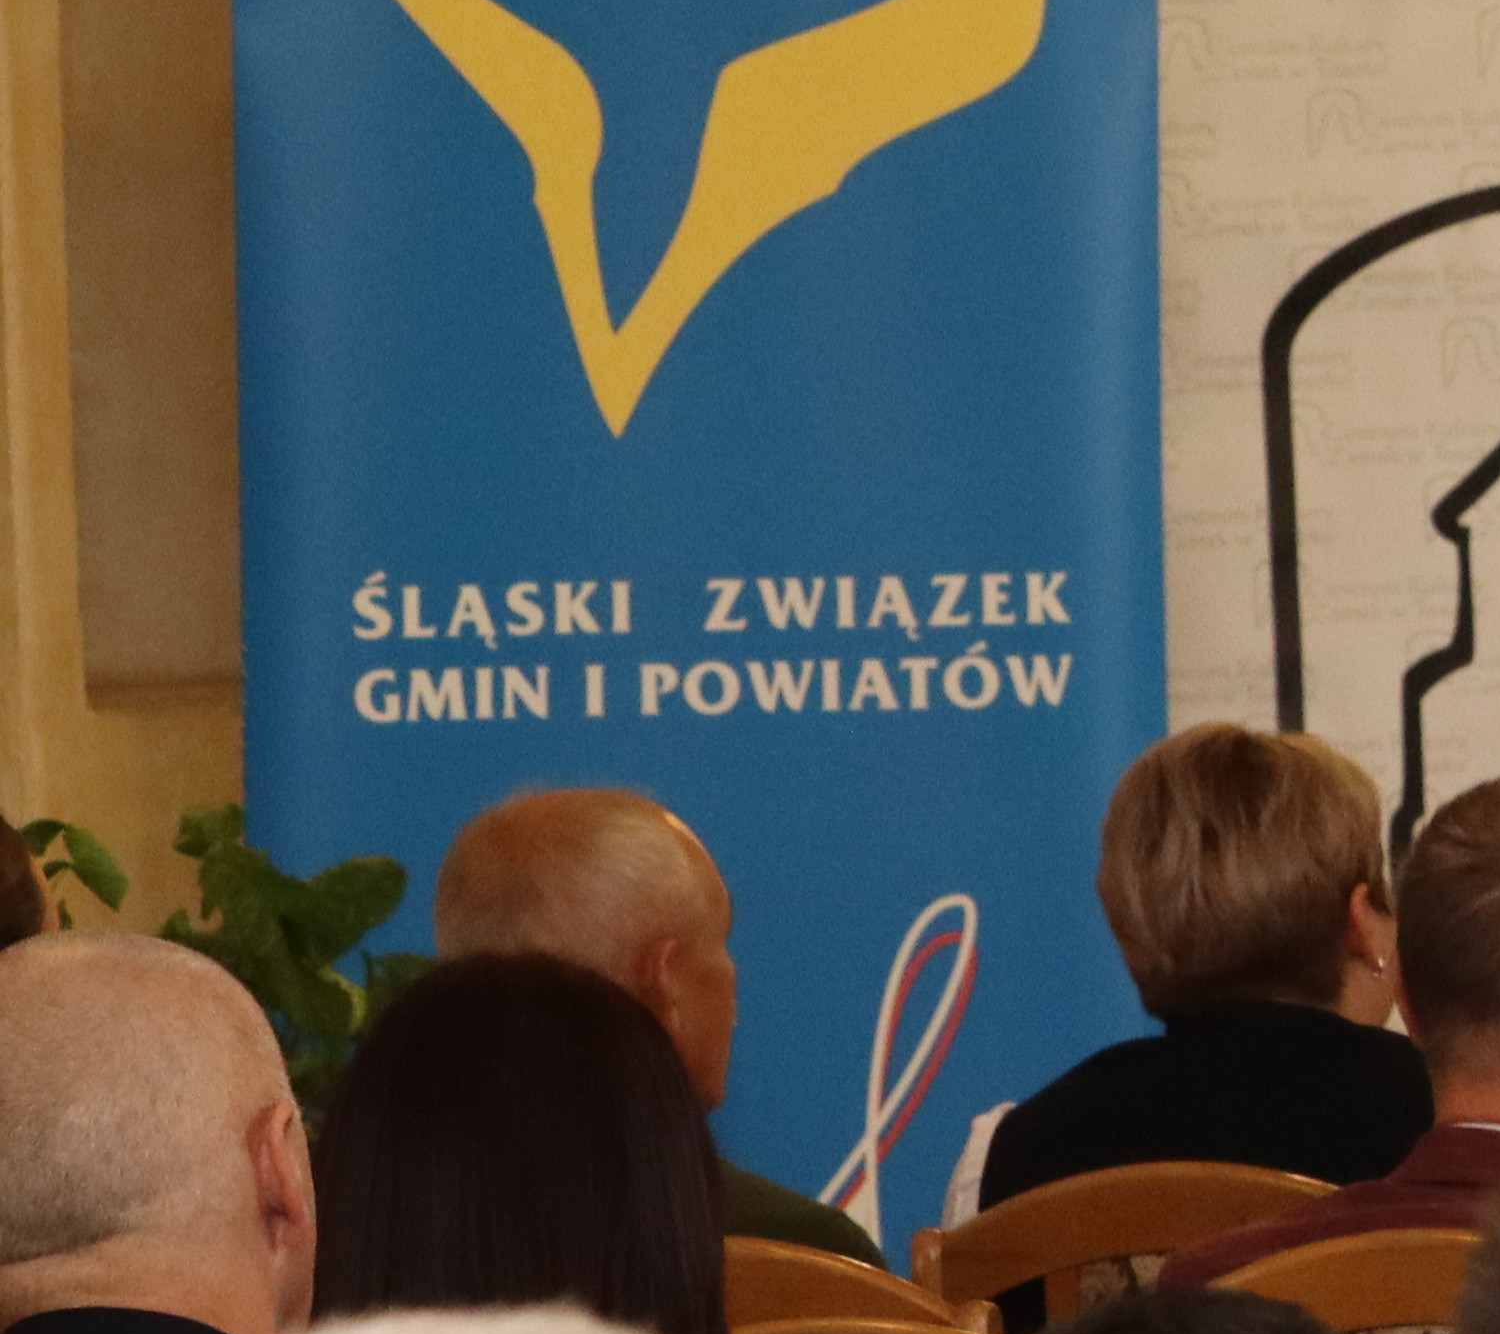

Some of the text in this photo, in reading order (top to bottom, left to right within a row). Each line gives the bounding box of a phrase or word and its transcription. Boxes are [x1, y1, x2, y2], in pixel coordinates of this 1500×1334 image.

[352, 571, 1072, 648] ŚLĄSKI ZWIĄZEK
[353, 641, 1073, 722] GMIN I POWIATÓW
